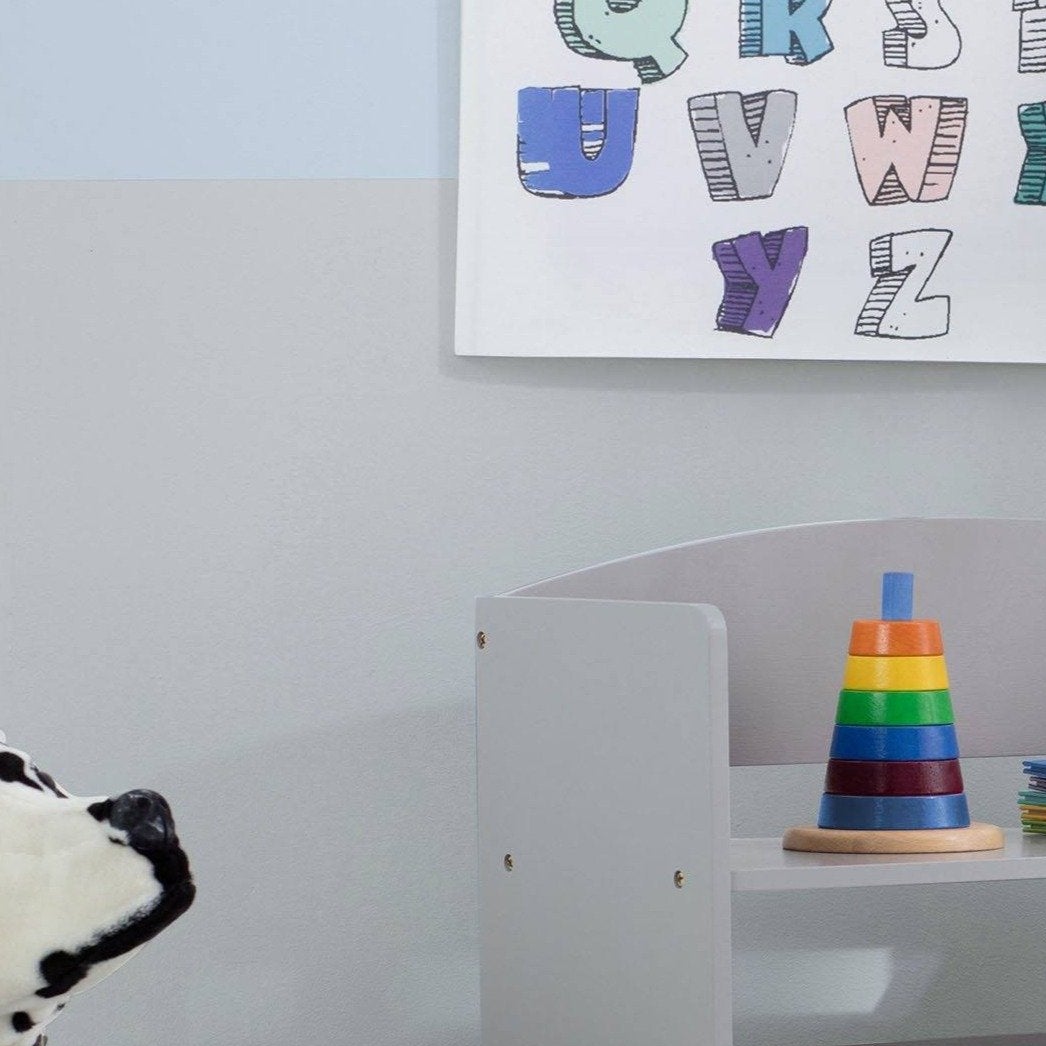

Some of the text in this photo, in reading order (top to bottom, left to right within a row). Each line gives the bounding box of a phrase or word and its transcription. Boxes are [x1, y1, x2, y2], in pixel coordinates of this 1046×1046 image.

[516, 85, 640, 199] U
[688, 90, 797, 201] V
[844, 94, 968, 205] W
[712, 226, 953, 339] Y Z
